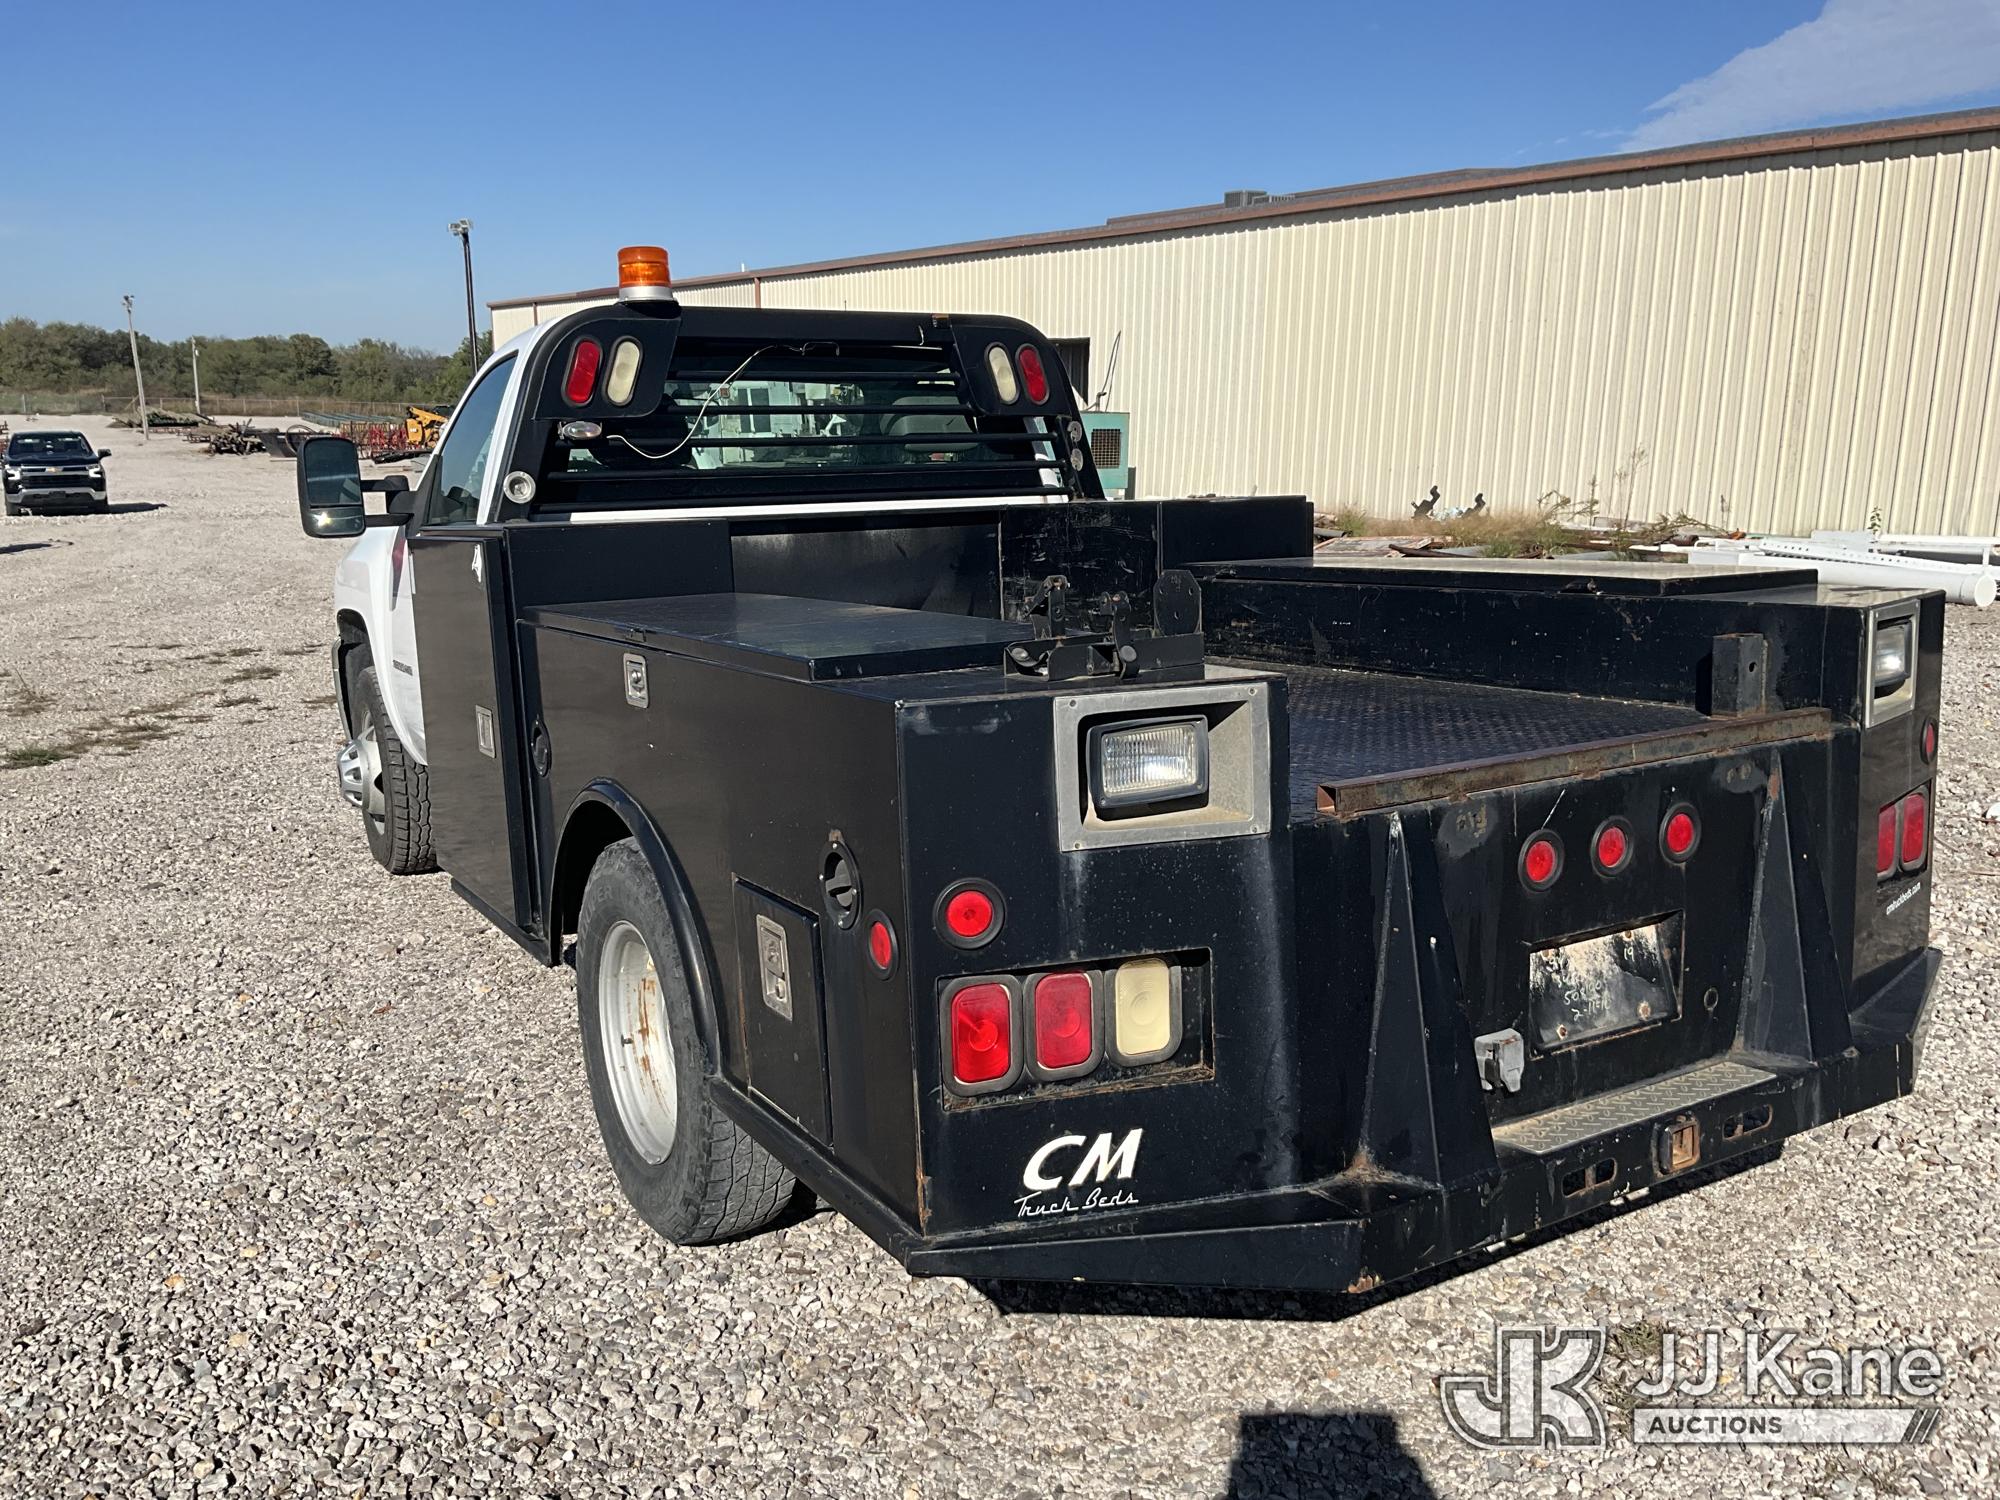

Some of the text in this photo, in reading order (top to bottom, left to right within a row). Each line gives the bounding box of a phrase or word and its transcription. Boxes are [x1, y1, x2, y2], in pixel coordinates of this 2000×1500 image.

[1023, 1128, 1143, 1191] CM
[1014, 1187, 1139, 1217] Truck Beds
